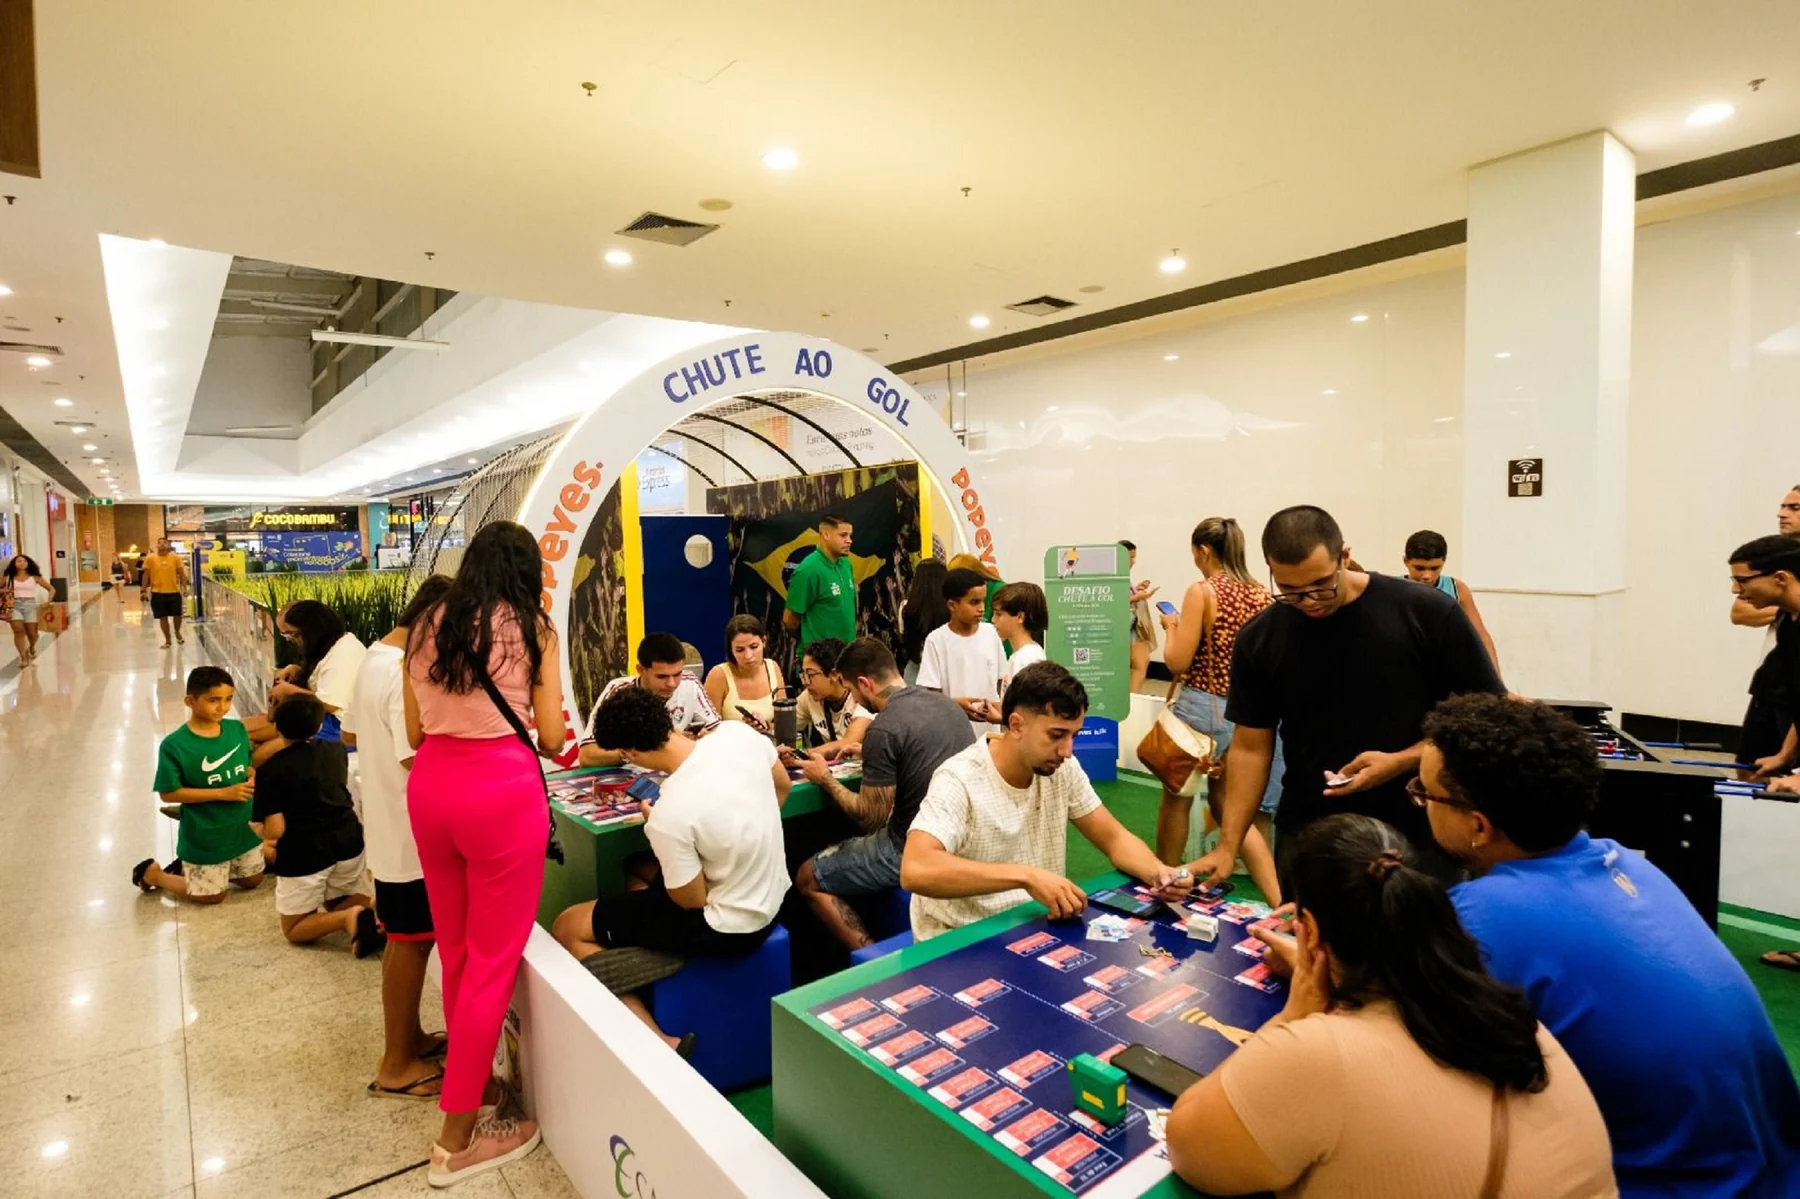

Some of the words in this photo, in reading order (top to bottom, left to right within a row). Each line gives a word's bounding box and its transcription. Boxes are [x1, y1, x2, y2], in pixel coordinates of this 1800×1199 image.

[663, 343, 766, 404] CHUTE
[795, 347, 833, 379] AO
[866, 376, 910, 427] GOL
[264, 513, 336, 526] COCOBAMBU
[1063, 585, 1111, 596] DESAFIO
[1058, 595, 1088, 603] CHUTE
[1097, 594, 1115, 602] GOL
[207, 764, 245, 785] AIR
